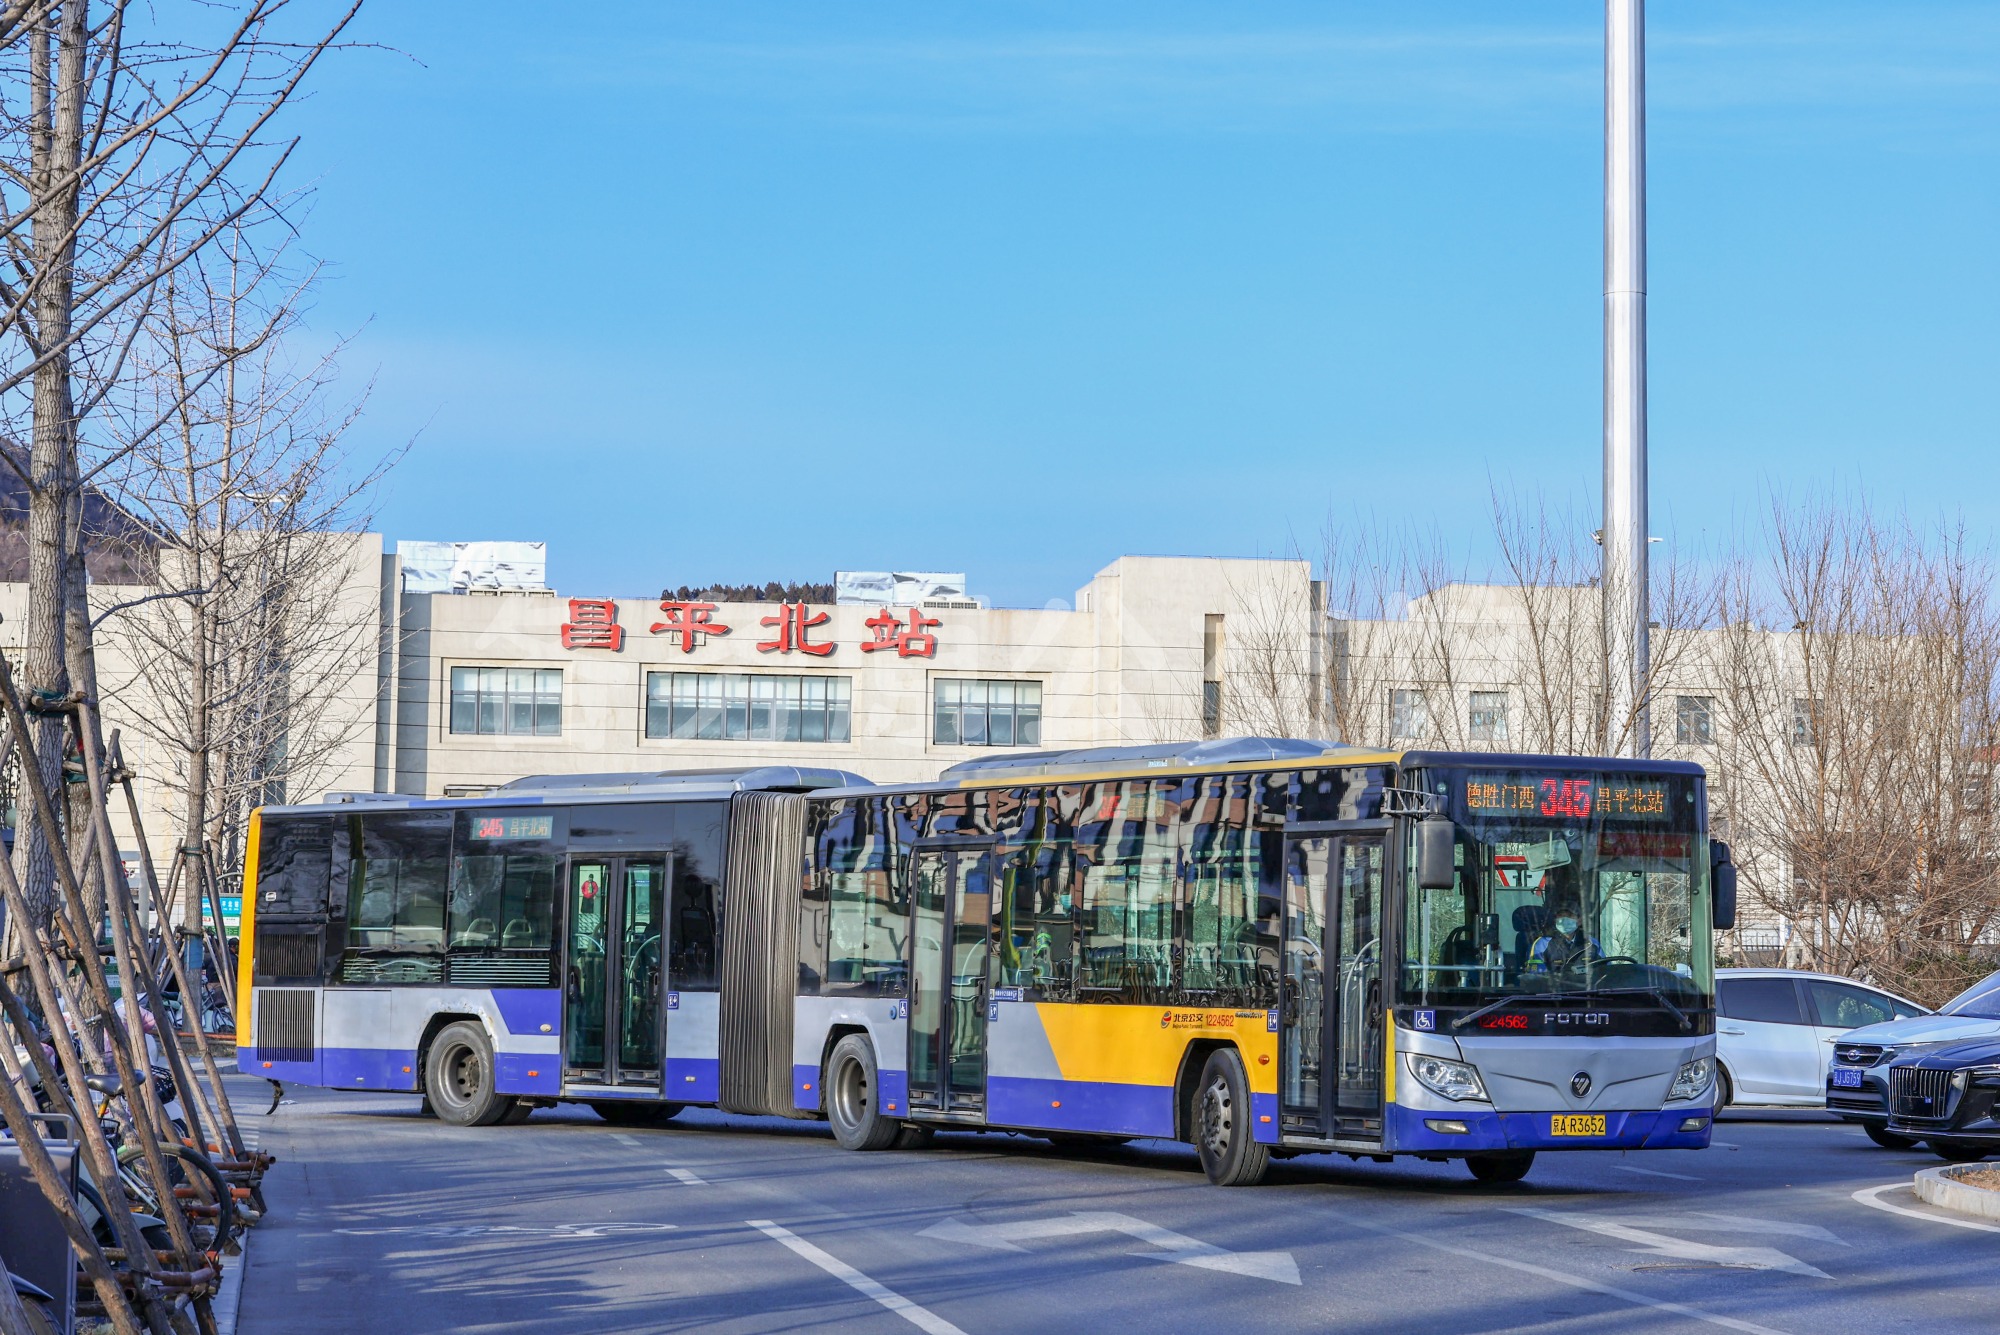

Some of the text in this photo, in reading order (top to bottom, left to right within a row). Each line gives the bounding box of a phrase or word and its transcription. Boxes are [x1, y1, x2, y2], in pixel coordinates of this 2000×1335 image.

[560, 599, 941, 658] 昌平北站
[1467, 778, 1664, 817] 德胜门西 345 昌平北站
[479, 817, 504, 838] 345
[1173, 1013, 1204, 1023] 北京公交
[1205, 1013, 1235, 1027] 1224562
